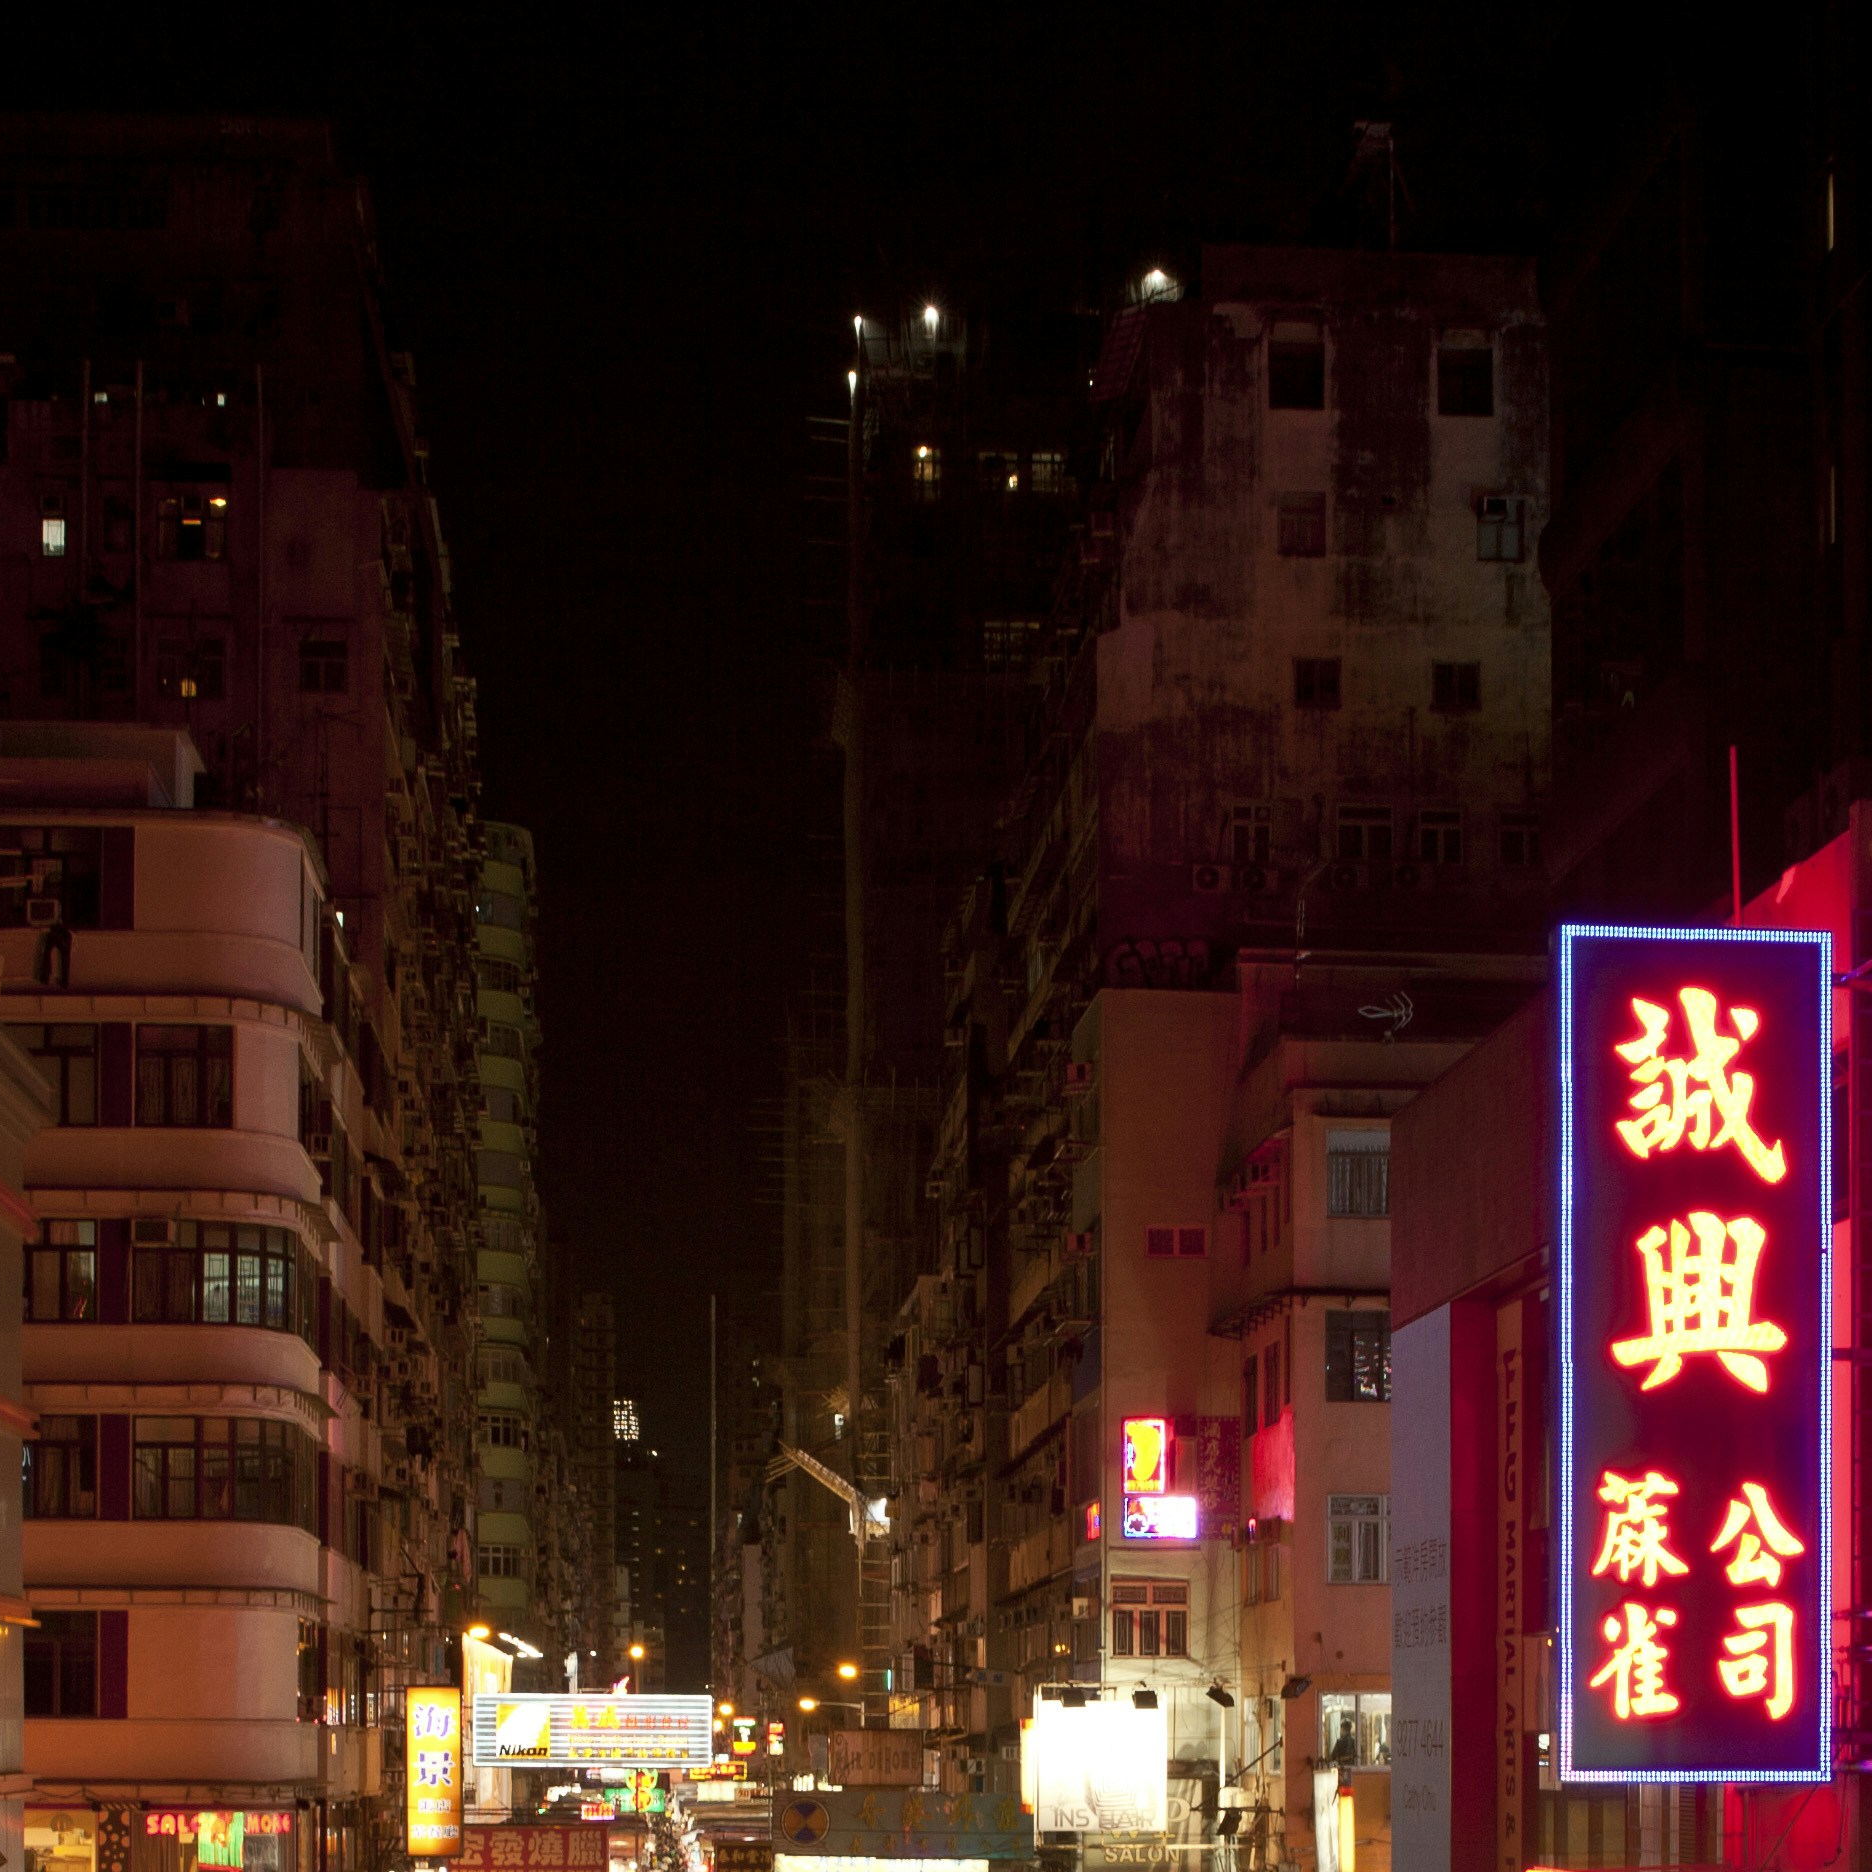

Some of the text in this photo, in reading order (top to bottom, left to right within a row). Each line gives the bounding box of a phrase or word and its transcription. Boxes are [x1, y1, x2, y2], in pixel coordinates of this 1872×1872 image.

[1611, 986, 1789, 1393] 誠興
[1504, 1519, 1517, 1683] MARTIAL
[1710, 1482, 1804, 1721] 公司
[499, 1745, 548, 1757] Nikon
[1504, 1702, 1517, 1797] ARTS
[1104, 1848, 1179, 1864] SALON
